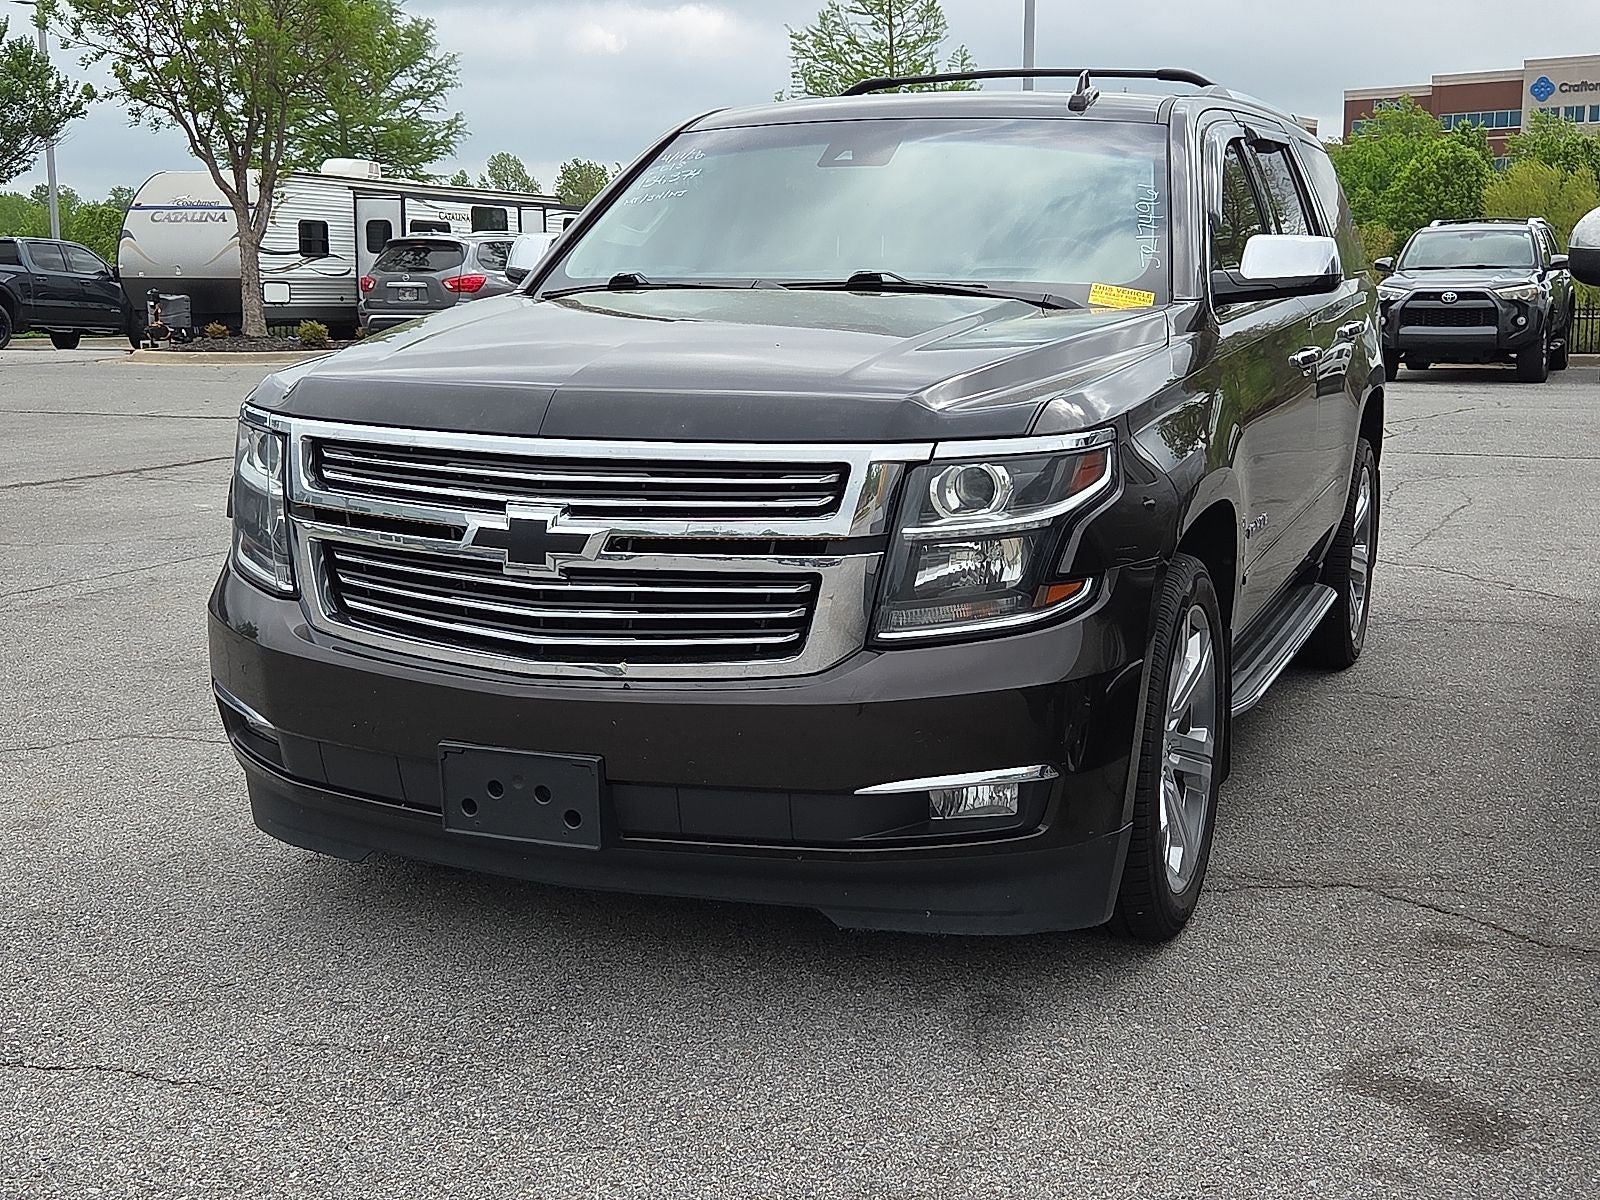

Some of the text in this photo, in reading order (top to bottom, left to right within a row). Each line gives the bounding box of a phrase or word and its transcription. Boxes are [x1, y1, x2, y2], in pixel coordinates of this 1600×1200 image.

[176, 199, 220, 207] Coachmen
[150, 211, 228, 223] CATALINA
[1094, 284, 1153, 299] THIS VEHICLE
